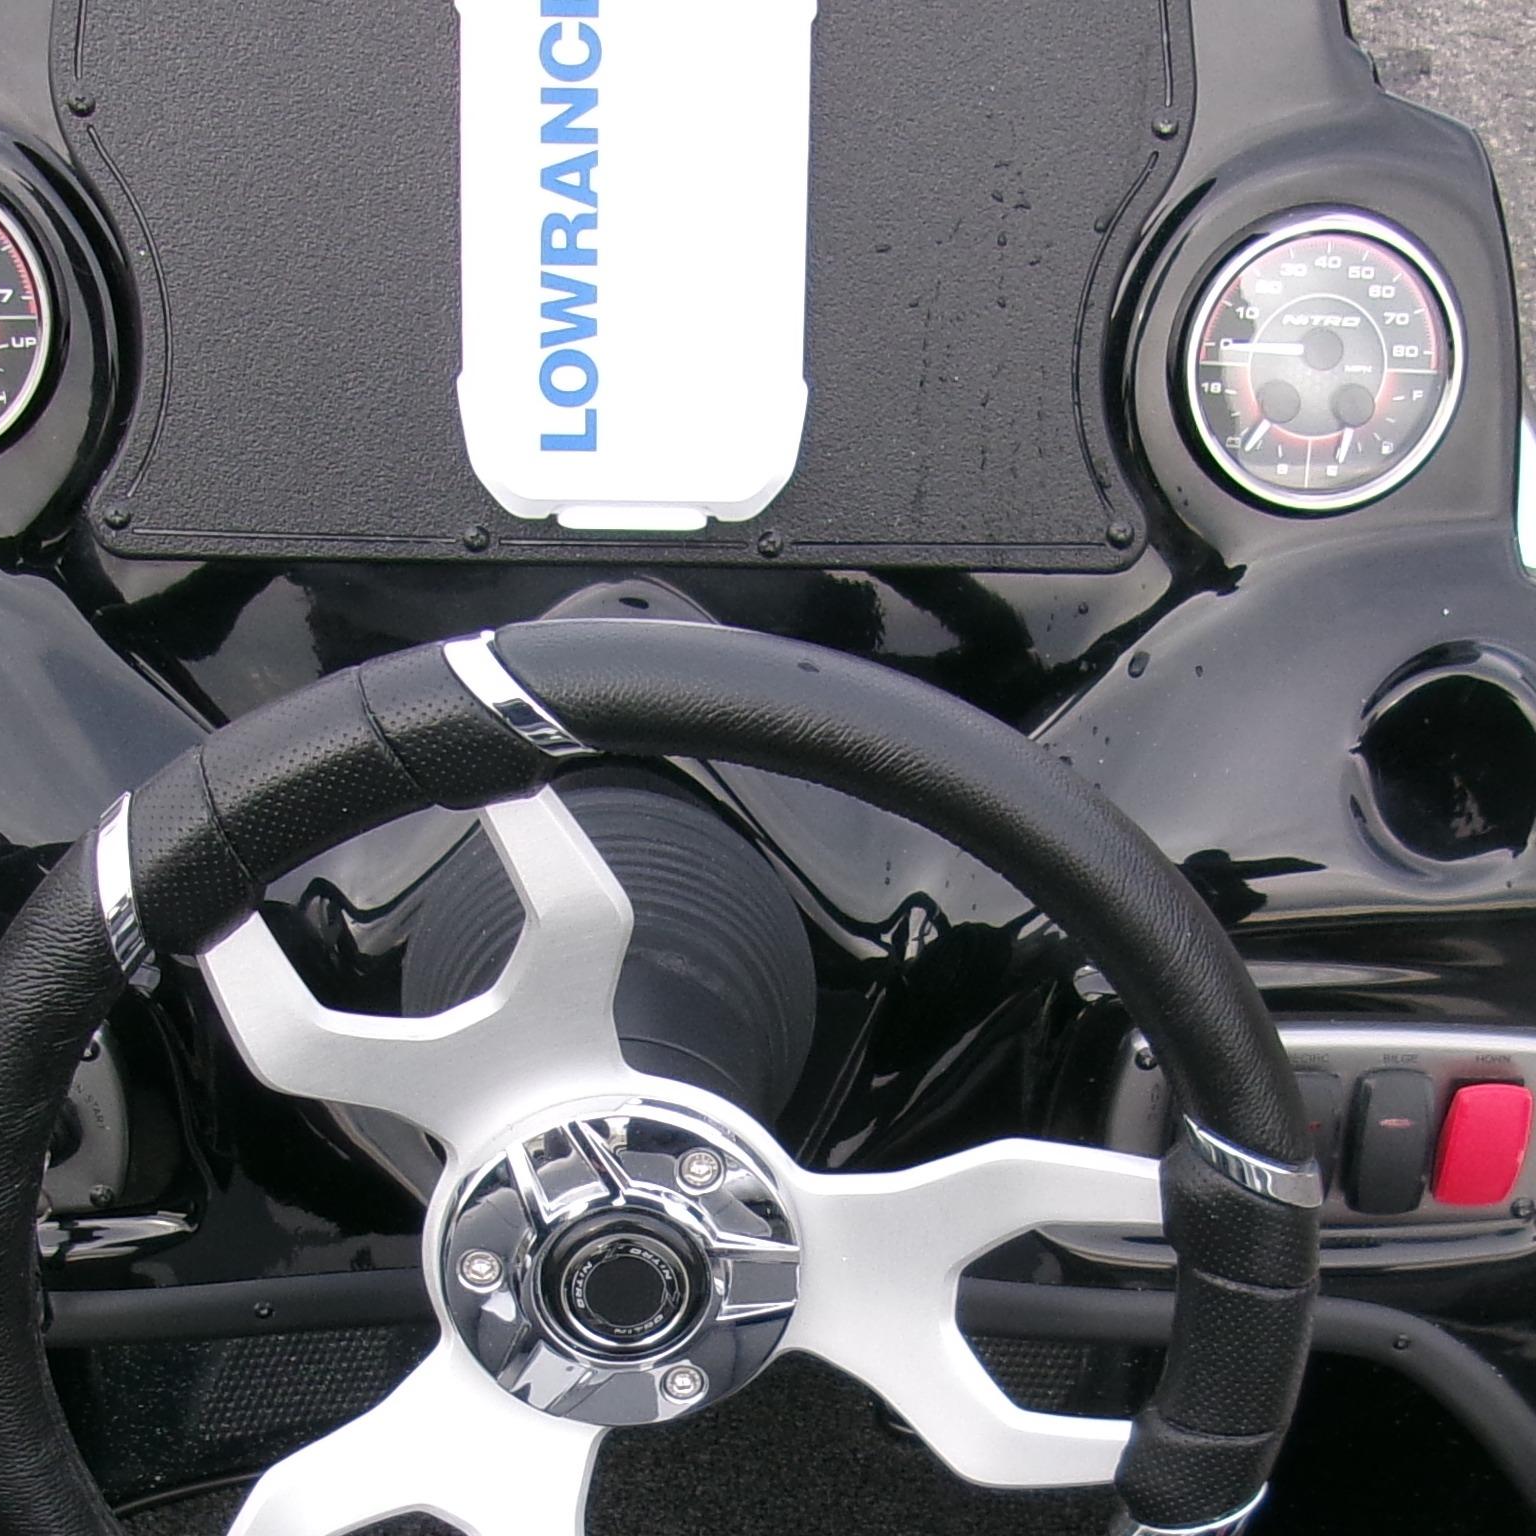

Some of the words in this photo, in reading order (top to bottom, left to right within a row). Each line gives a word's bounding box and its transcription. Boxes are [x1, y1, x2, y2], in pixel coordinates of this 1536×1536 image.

[1314, 256, 1342, 268] 40
[1280, 263, 1308, 277] 30
[1348, 266, 1375, 280] 50
[1368, 286, 1395, 298] 60
[1236, 306, 1259, 320] 10
[1383, 313, 1409, 325] 70
[1282, 315, 1361, 327] NITRO
[11, 338, 37, 348] UP
[1392, 346, 1418, 358] 80
[1412, 391, 1424, 401] F
